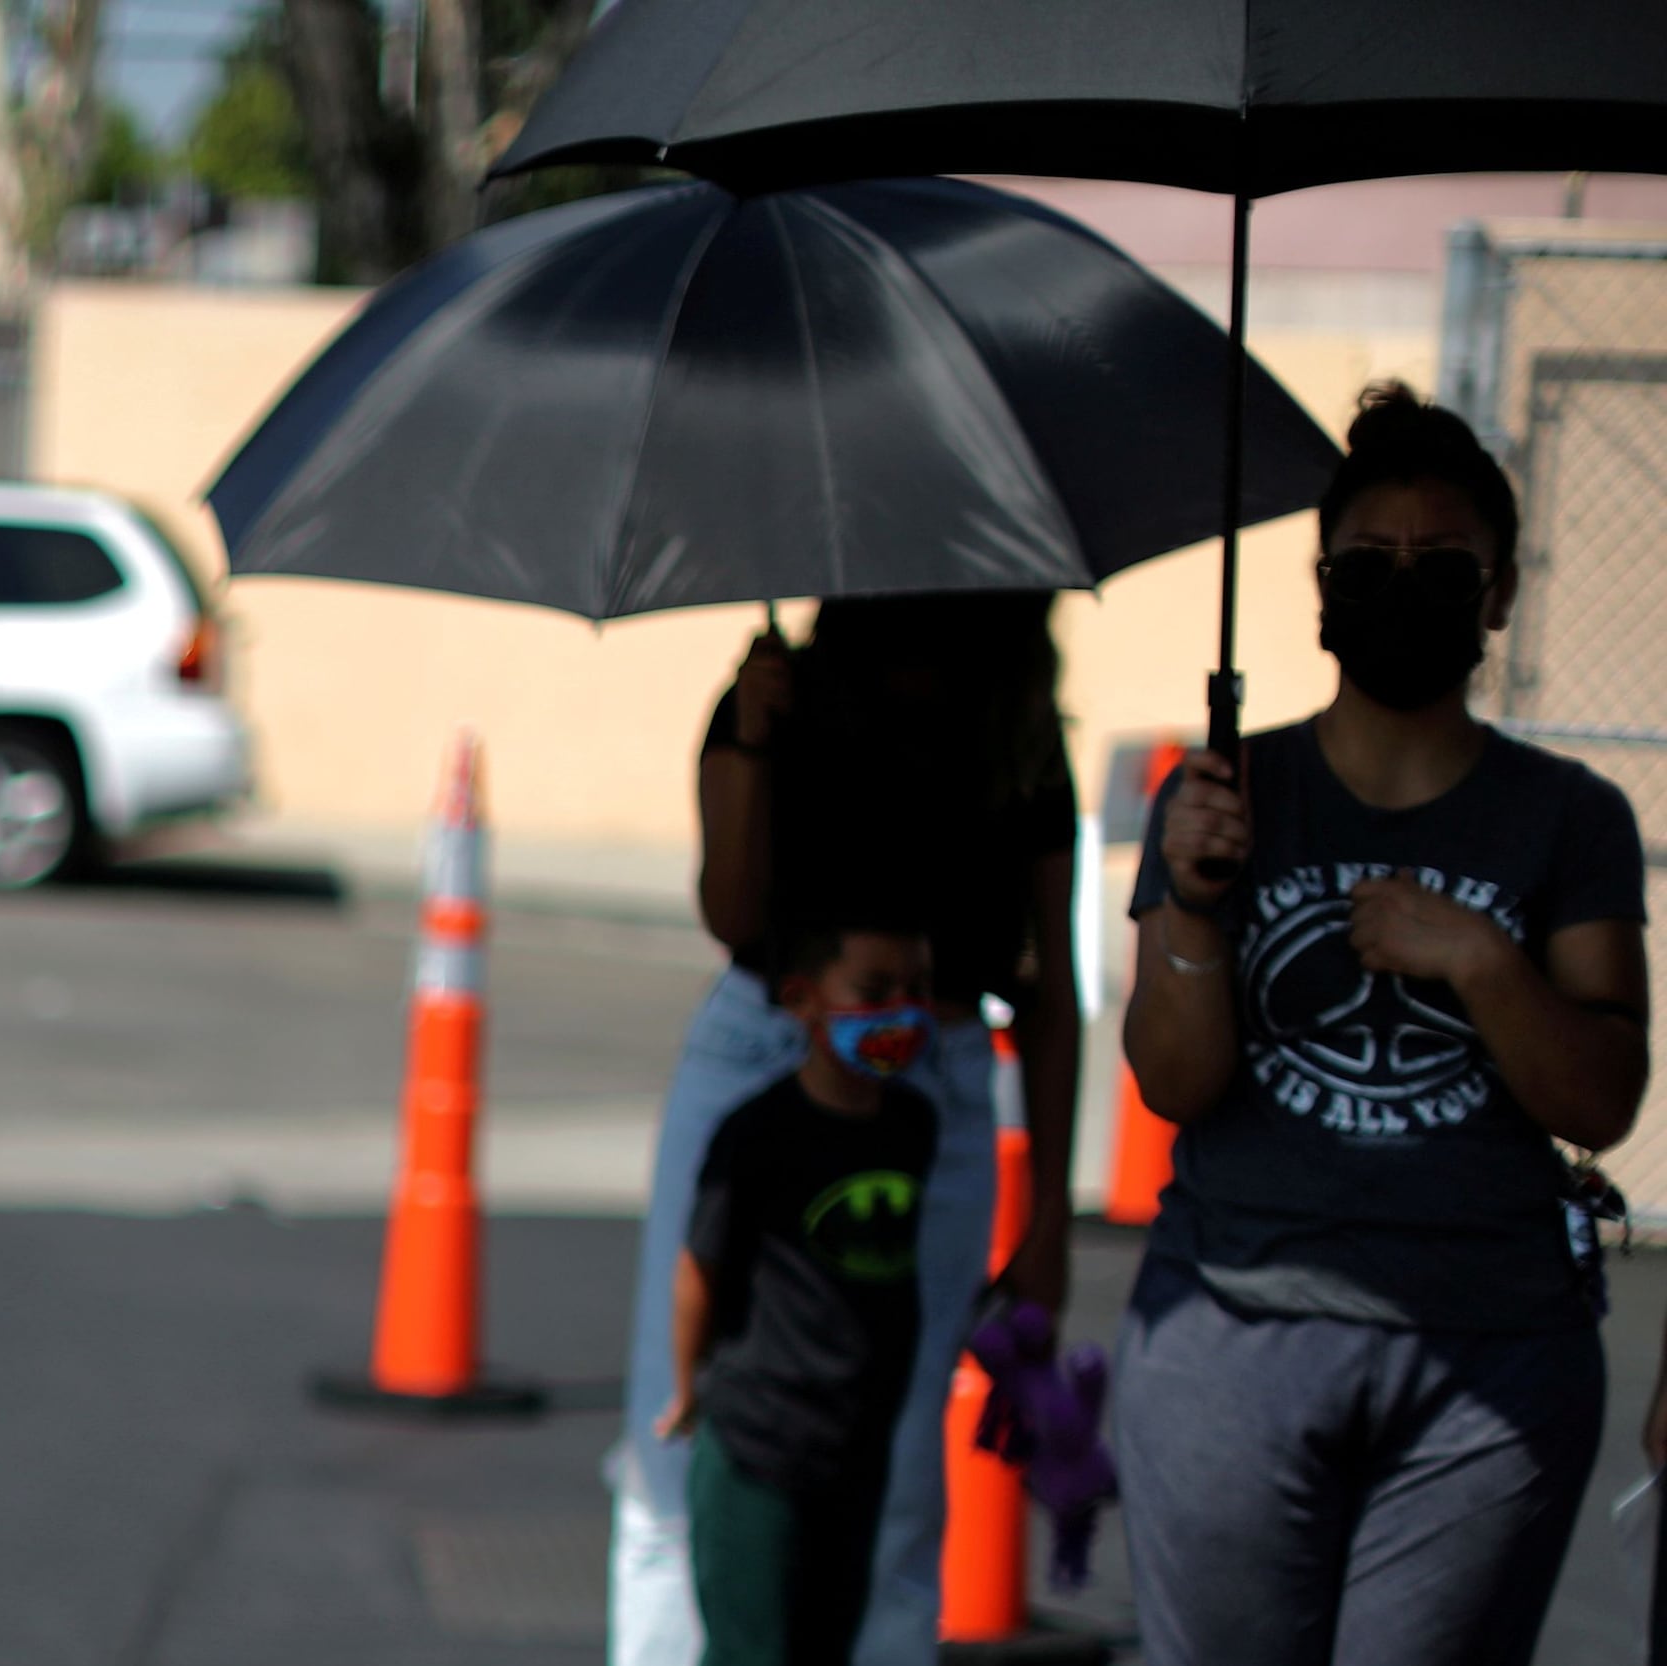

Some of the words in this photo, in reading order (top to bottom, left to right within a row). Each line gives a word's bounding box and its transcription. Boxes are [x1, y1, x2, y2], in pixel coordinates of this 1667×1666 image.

[1257, 865, 1325, 921] YOU
[1334, 861, 1446, 895] NED
[1453, 876, 1500, 911] IS
[1274, 1069, 1321, 1116] IS
[1320, 1092, 1409, 1134] ALL
[1411, 1072, 1489, 1128] YOU
